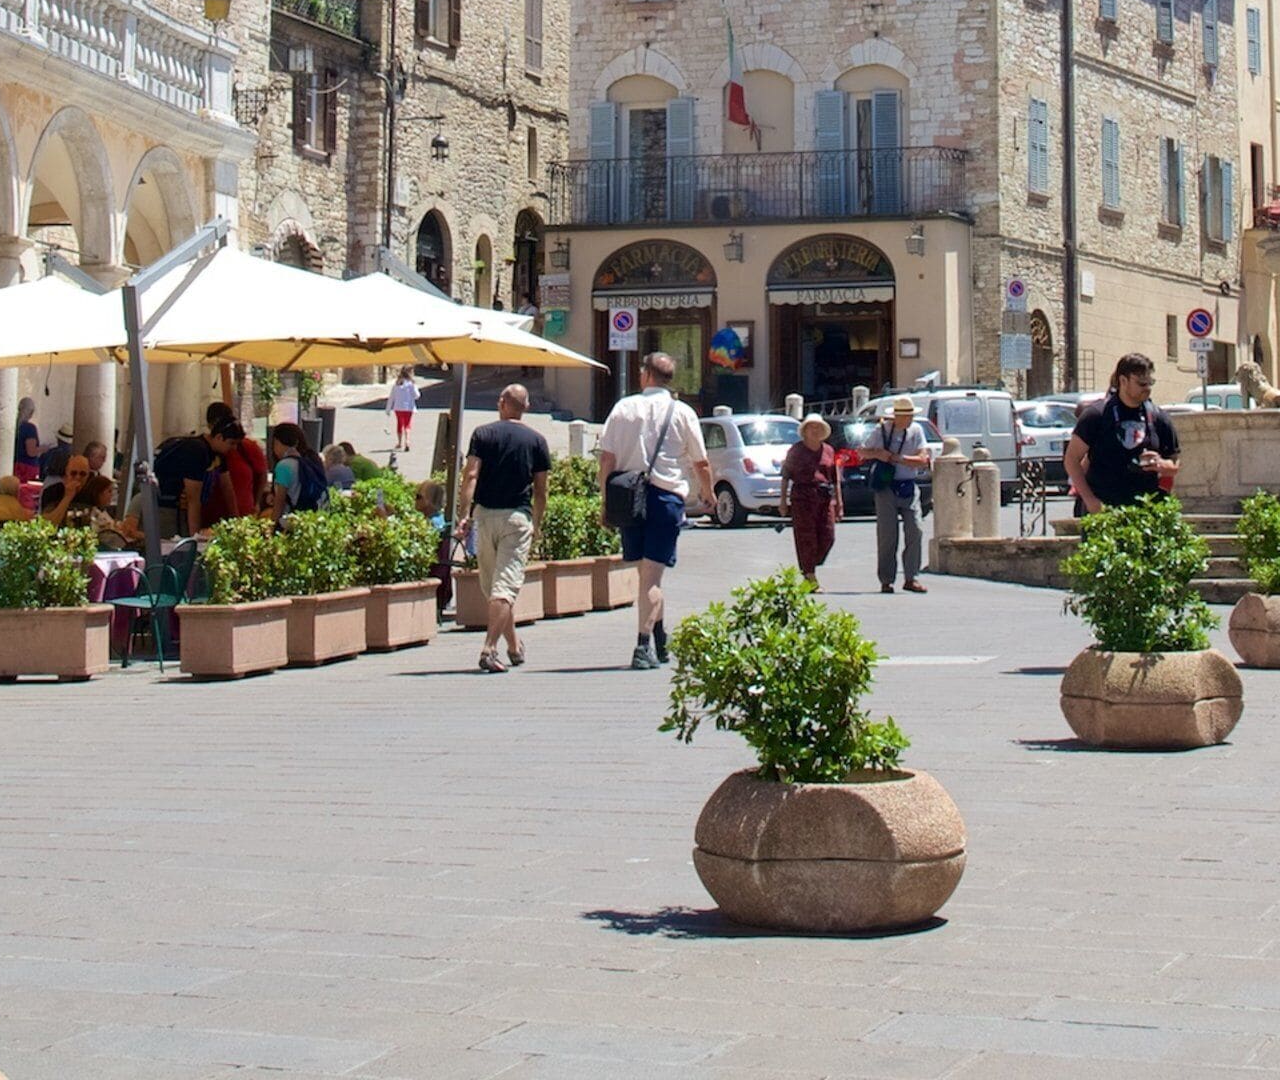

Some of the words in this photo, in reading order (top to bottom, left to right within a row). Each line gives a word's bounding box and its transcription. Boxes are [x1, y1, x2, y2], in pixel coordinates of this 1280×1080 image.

[612, 244, 701, 277] FARMACIA
[607, 294, 700, 308] ERBORISTERIA
[796, 288, 866, 301] FARMACIA
